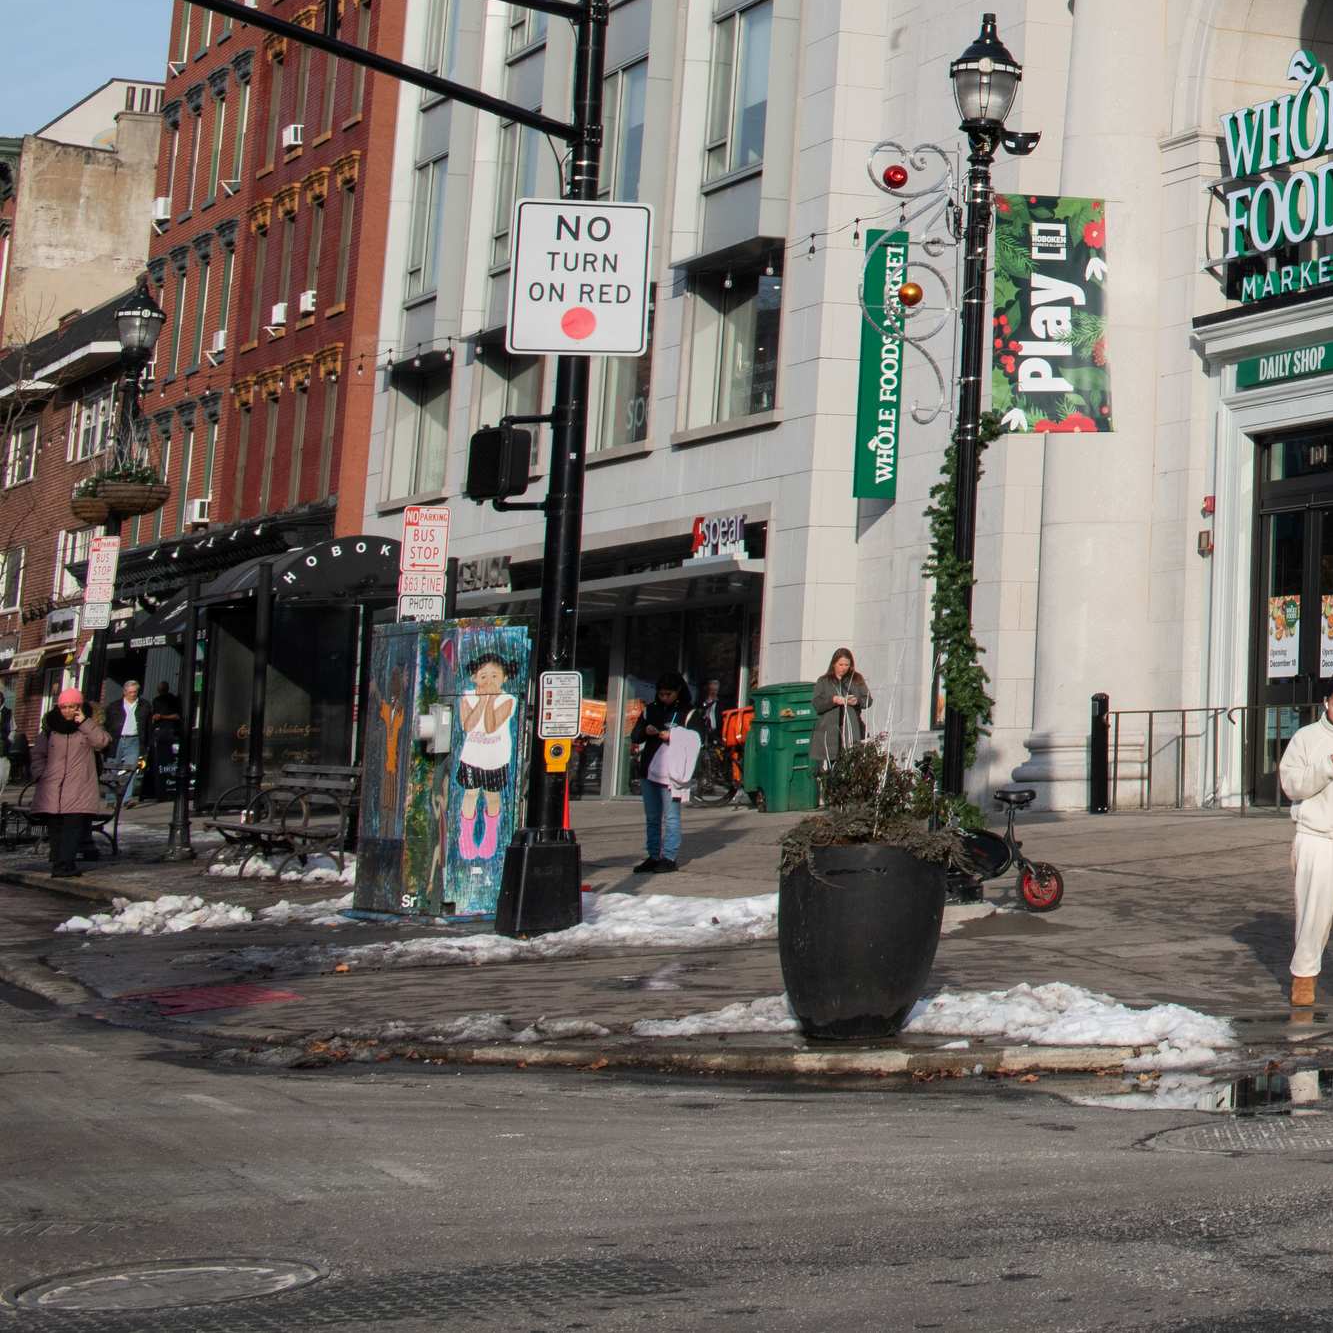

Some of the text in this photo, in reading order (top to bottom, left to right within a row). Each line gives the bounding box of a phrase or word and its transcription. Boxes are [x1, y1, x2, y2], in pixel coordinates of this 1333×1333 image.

[556, 215, 611, 241] NO
[547, 252, 618, 273] TURN
[529, 282, 631, 304] ON RED
[1018, 272, 1086, 392] Play
[880, 334, 900, 402] FOODS
[1259, 346, 1325, 381] DAILY SHOP
[867, 408, 896, 484] WHOLE
[406, 510, 448, 522] NO PARKING
[413, 529, 435, 542] BUS
[704, 517, 741, 547] spear
[96, 553, 110, 563] BUS
[410, 547, 439, 560] STOP
[94, 566, 111, 575] STOP
[403, 577, 441, 592] $63 FINE
[409, 598, 433, 610] PHOTO
